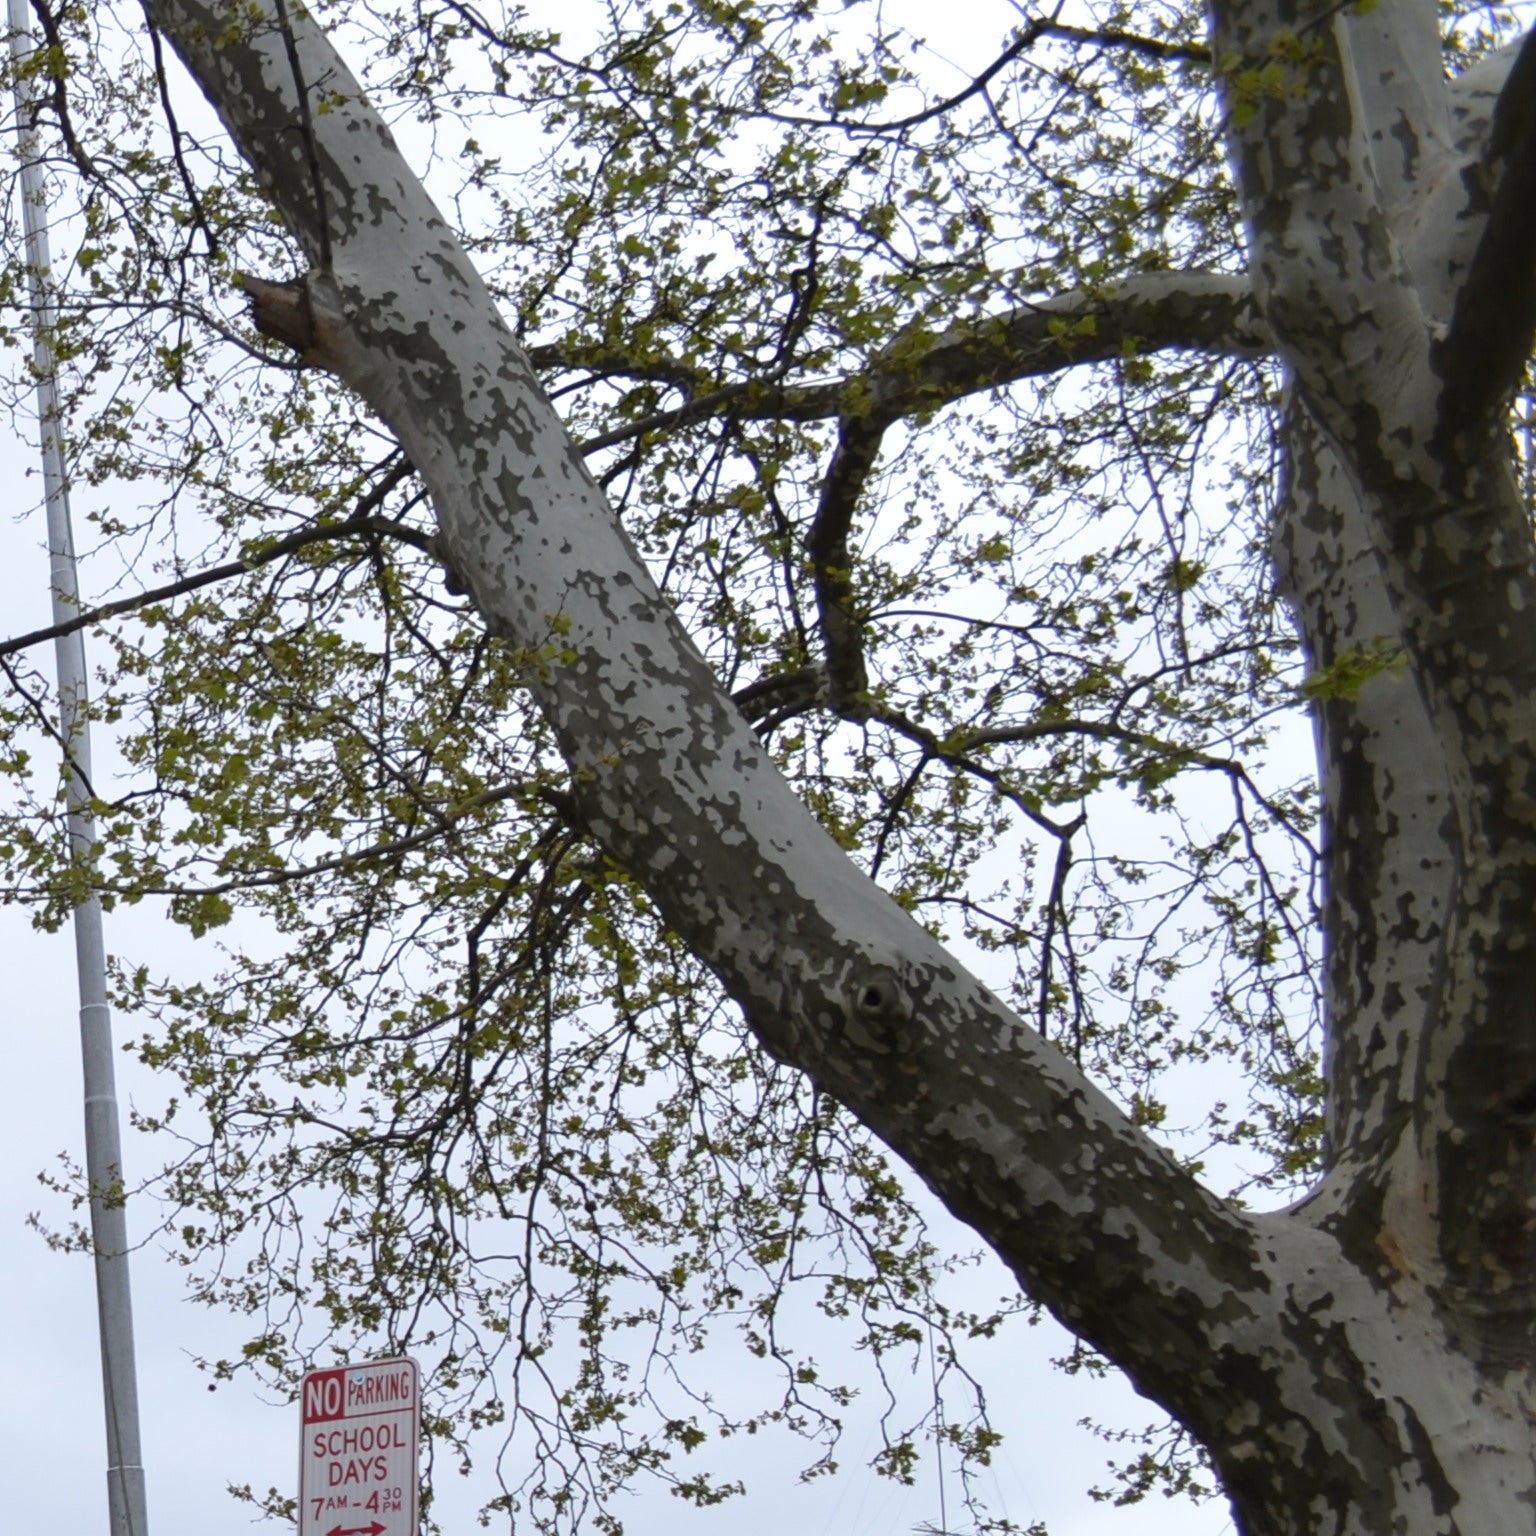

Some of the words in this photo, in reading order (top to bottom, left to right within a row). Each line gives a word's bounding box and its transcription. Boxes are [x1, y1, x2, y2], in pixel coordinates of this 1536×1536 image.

[307, 1377, 341, 1417] NO
[348, 1371, 409, 1406] PARKING
[313, 1423, 406, 1458] SCHOOL
[329, 1455, 387, 1486] DAYS
